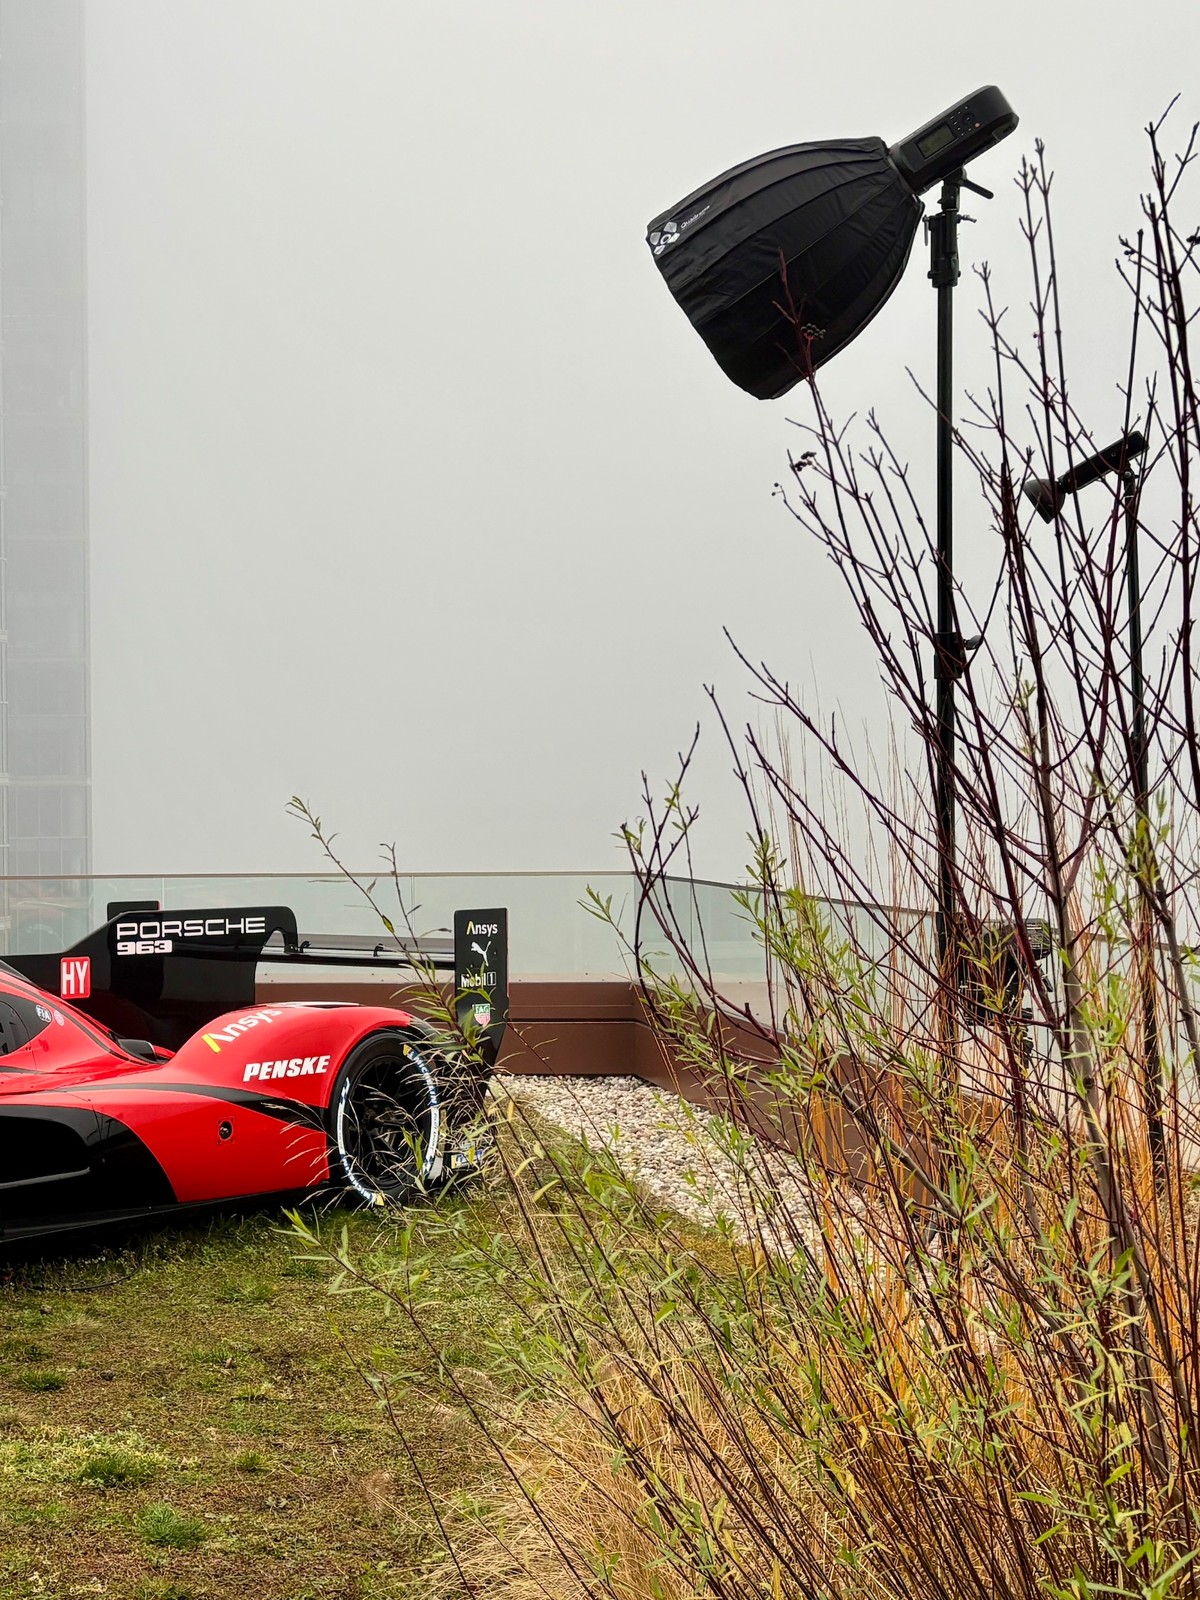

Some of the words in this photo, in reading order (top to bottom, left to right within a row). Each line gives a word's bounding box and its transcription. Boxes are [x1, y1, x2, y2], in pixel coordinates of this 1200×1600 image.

[116, 917, 266, 940] PORSCHE
[466, 921, 498, 937] Ansys
[116, 939, 173, 956] 963
[61, 960, 89, 995] HY
[461, 973, 487, 987] Mbl
[201, 1008, 282, 1053] Ansys
[242, 1055, 331, 1082] PENSKE
